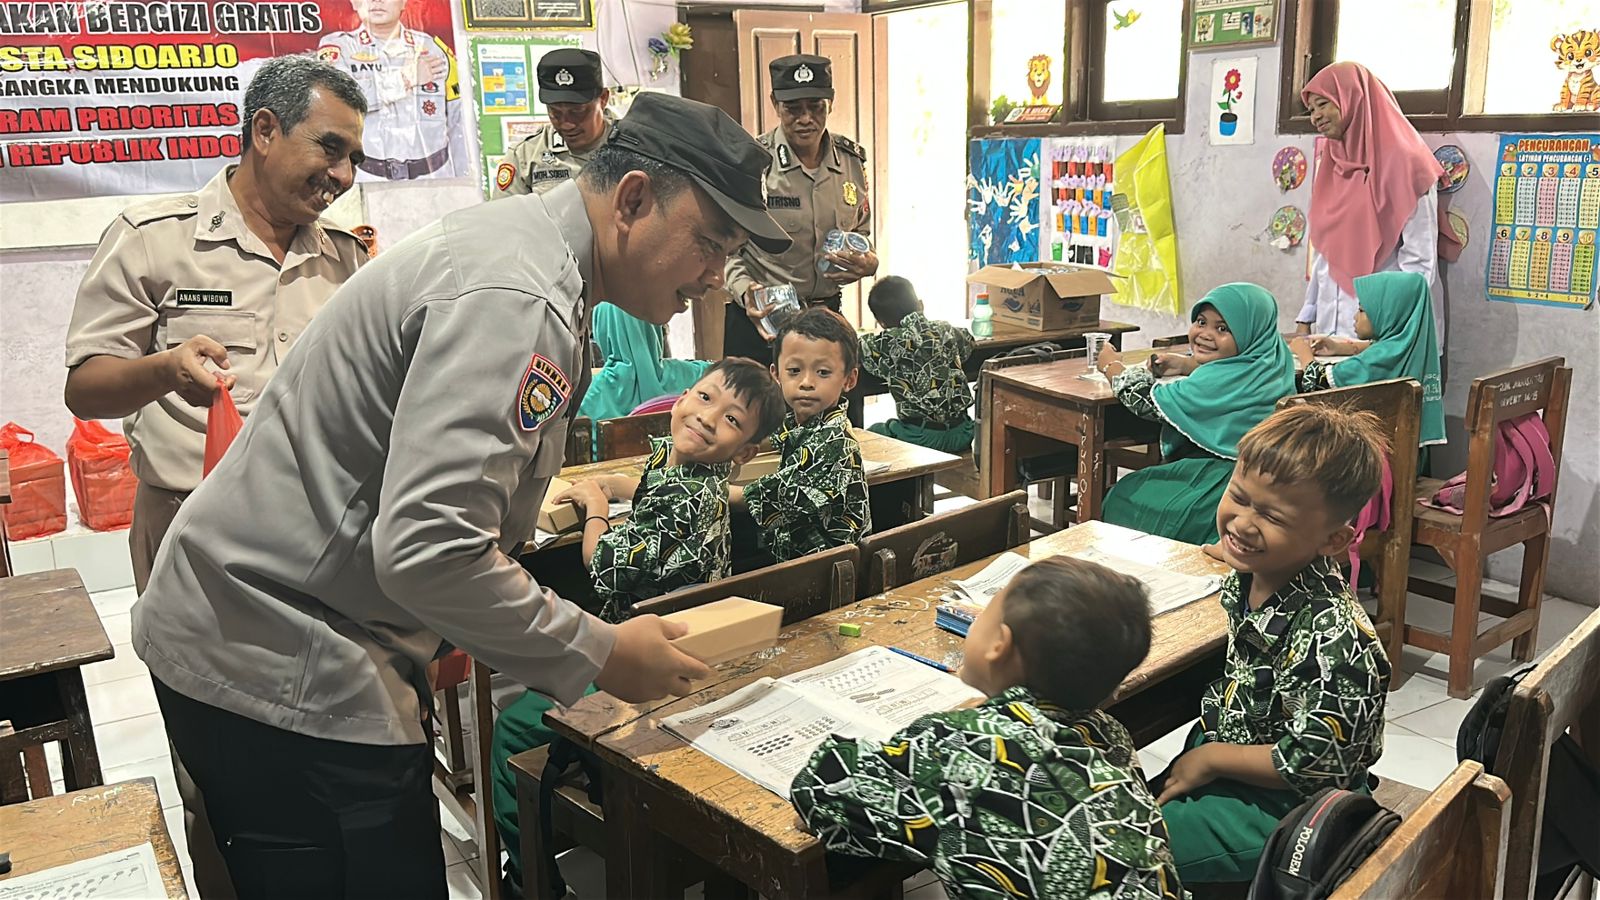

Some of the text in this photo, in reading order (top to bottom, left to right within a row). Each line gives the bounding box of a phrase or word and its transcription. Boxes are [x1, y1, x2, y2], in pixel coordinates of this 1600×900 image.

[85, 2, 210, 34] BERGIZI
[215, 2, 322, 33] GRATIS
[72, 43, 239, 71] SIDOARJO
[351, 63, 382, 73] BAYU
[0, 75, 239, 97] ANGKA MENDUKUNG
[76, 103, 240, 131] PRIORITAS
[8, 134, 243, 167] REPUBLIK INDO
[179, 293, 229, 303] ANANG WIBOWO
[1288, 825, 1314, 877] POLOGEM
